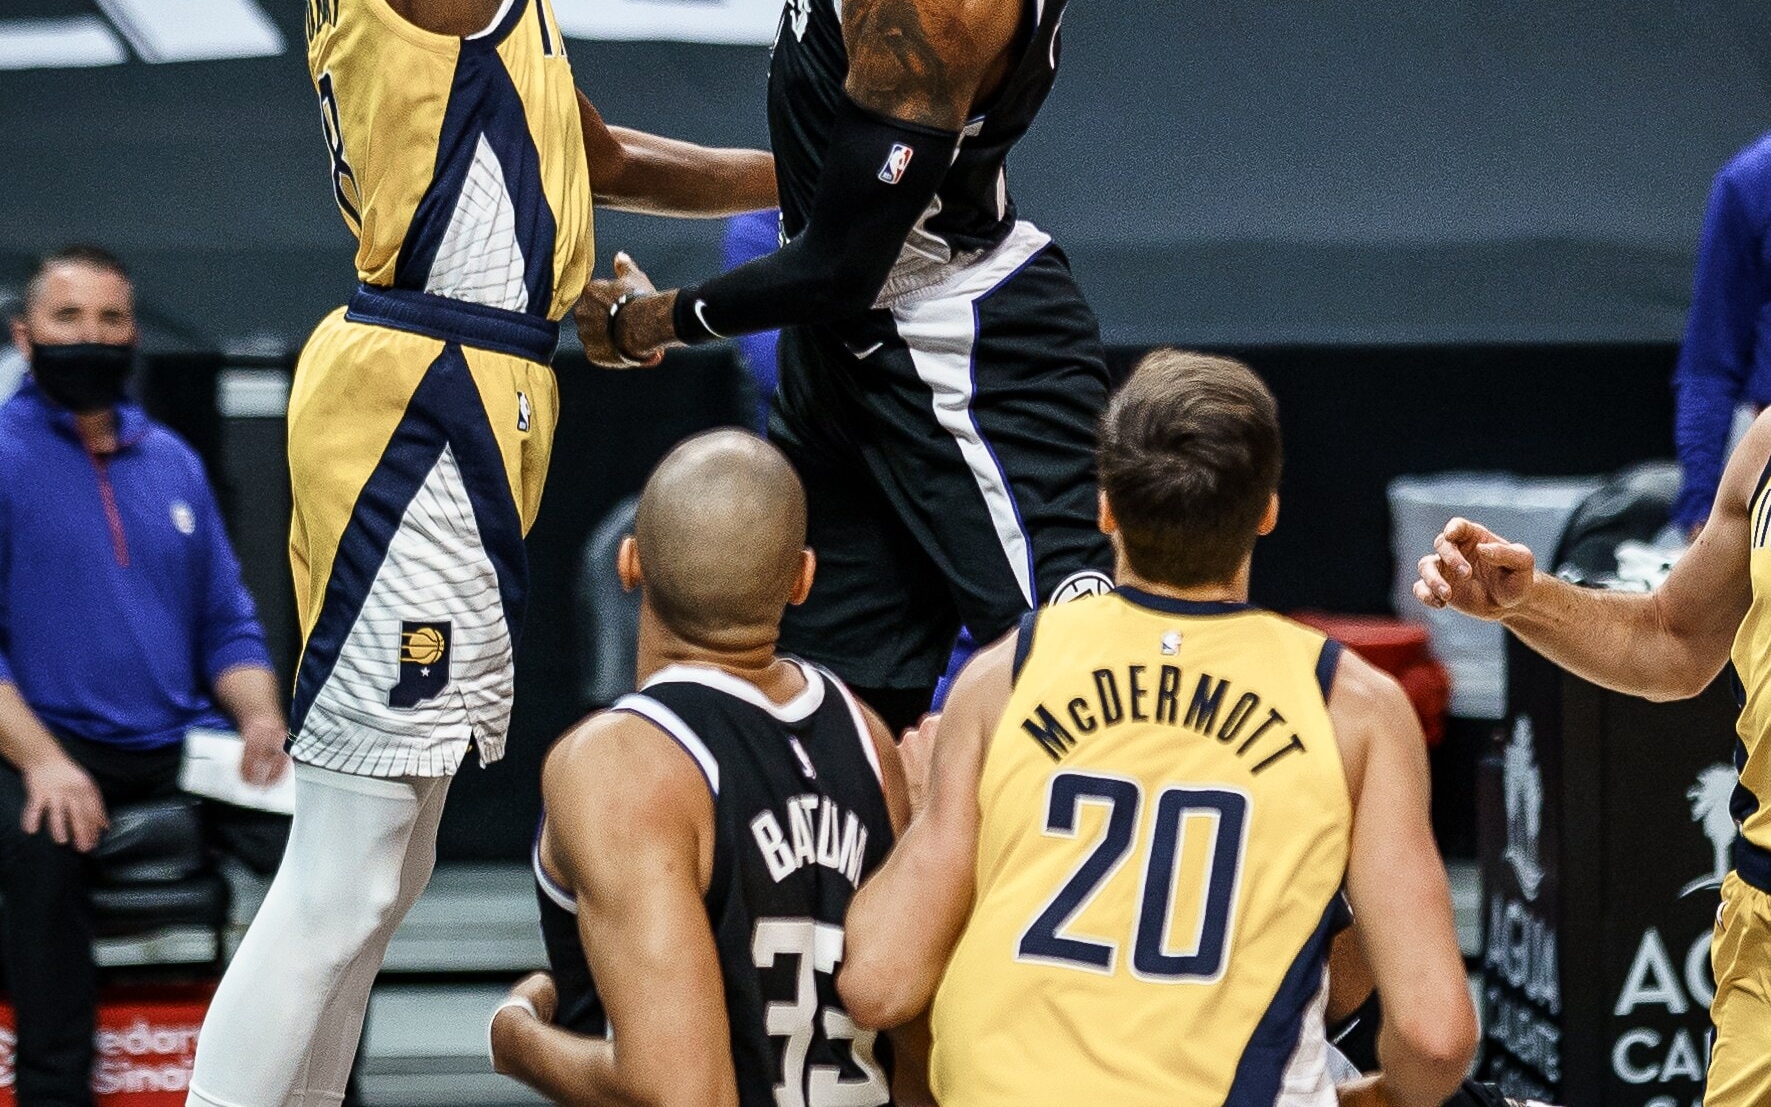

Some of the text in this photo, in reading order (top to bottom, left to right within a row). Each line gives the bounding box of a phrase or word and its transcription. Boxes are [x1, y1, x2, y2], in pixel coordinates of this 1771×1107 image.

[750, 794, 868, 891] BATUM
[1013, 768, 1254, 985] 20
[1611, 1026, 1714, 1084] CA
